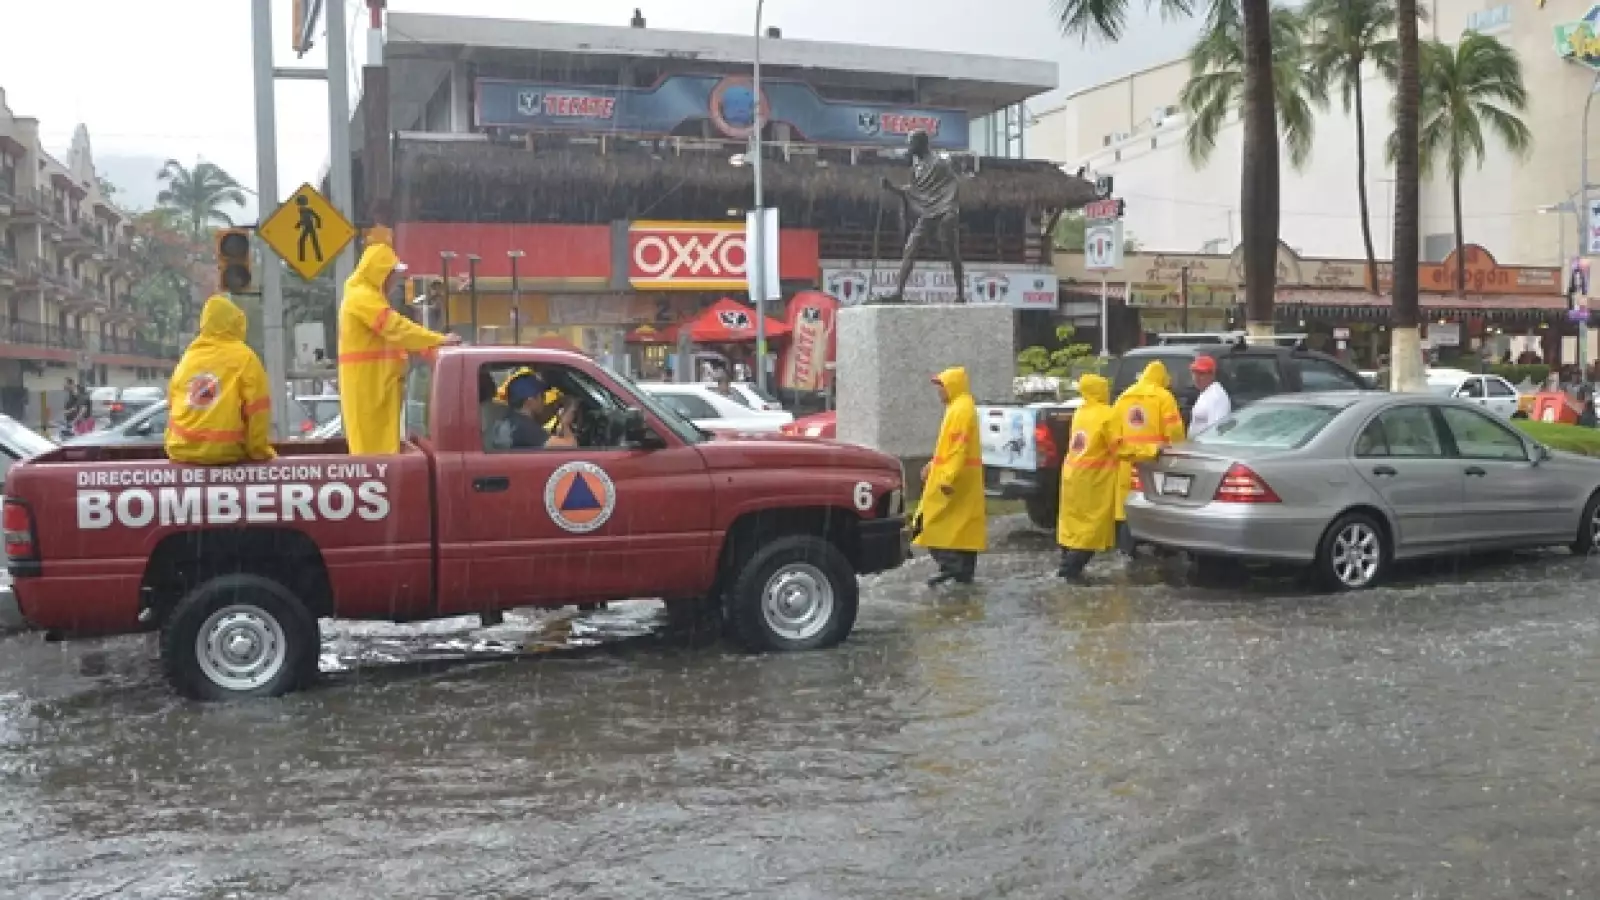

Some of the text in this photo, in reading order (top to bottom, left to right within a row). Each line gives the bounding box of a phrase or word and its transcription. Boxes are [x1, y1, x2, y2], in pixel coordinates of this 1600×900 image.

[543, 94, 615, 119] TECATE
[881, 113, 940, 135] TECATE
[634, 231, 747, 279] OXXO
[793, 323, 817, 383] TECATE
[77, 463, 388, 486] DIRECCION DE PROTECCION CIVIL Y
[77, 480, 391, 529] BOMBEROS
[853, 481, 873, 511] 6
